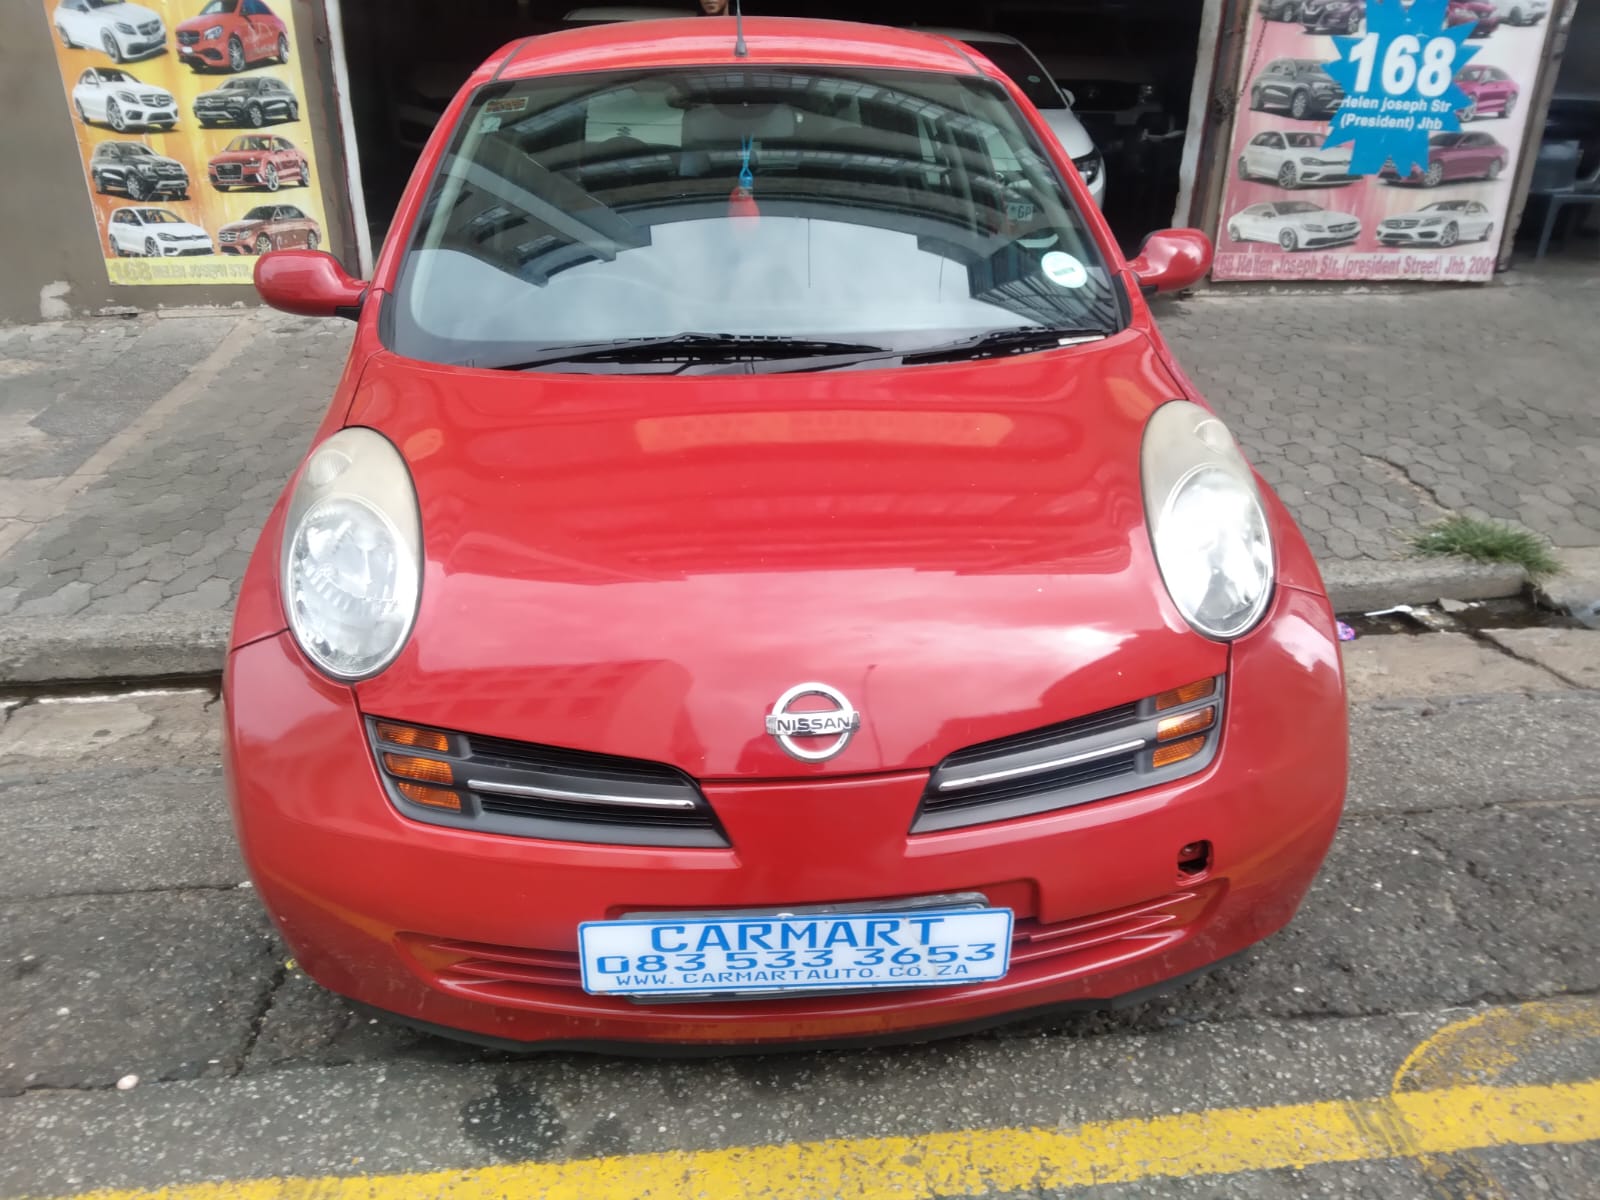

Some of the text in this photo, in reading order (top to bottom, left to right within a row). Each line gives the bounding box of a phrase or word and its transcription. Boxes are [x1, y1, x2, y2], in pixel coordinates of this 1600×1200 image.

[1348, 32, 1456, 97] 168
[1339, 95, 1452, 113] Helen joseph Str
[1340, 113, 1443, 131] (President) Jhb
[777, 716, 851, 732] NISSAN
[651, 918, 945, 953] CARMART
[597, 943, 996, 975] 083 533 3653
